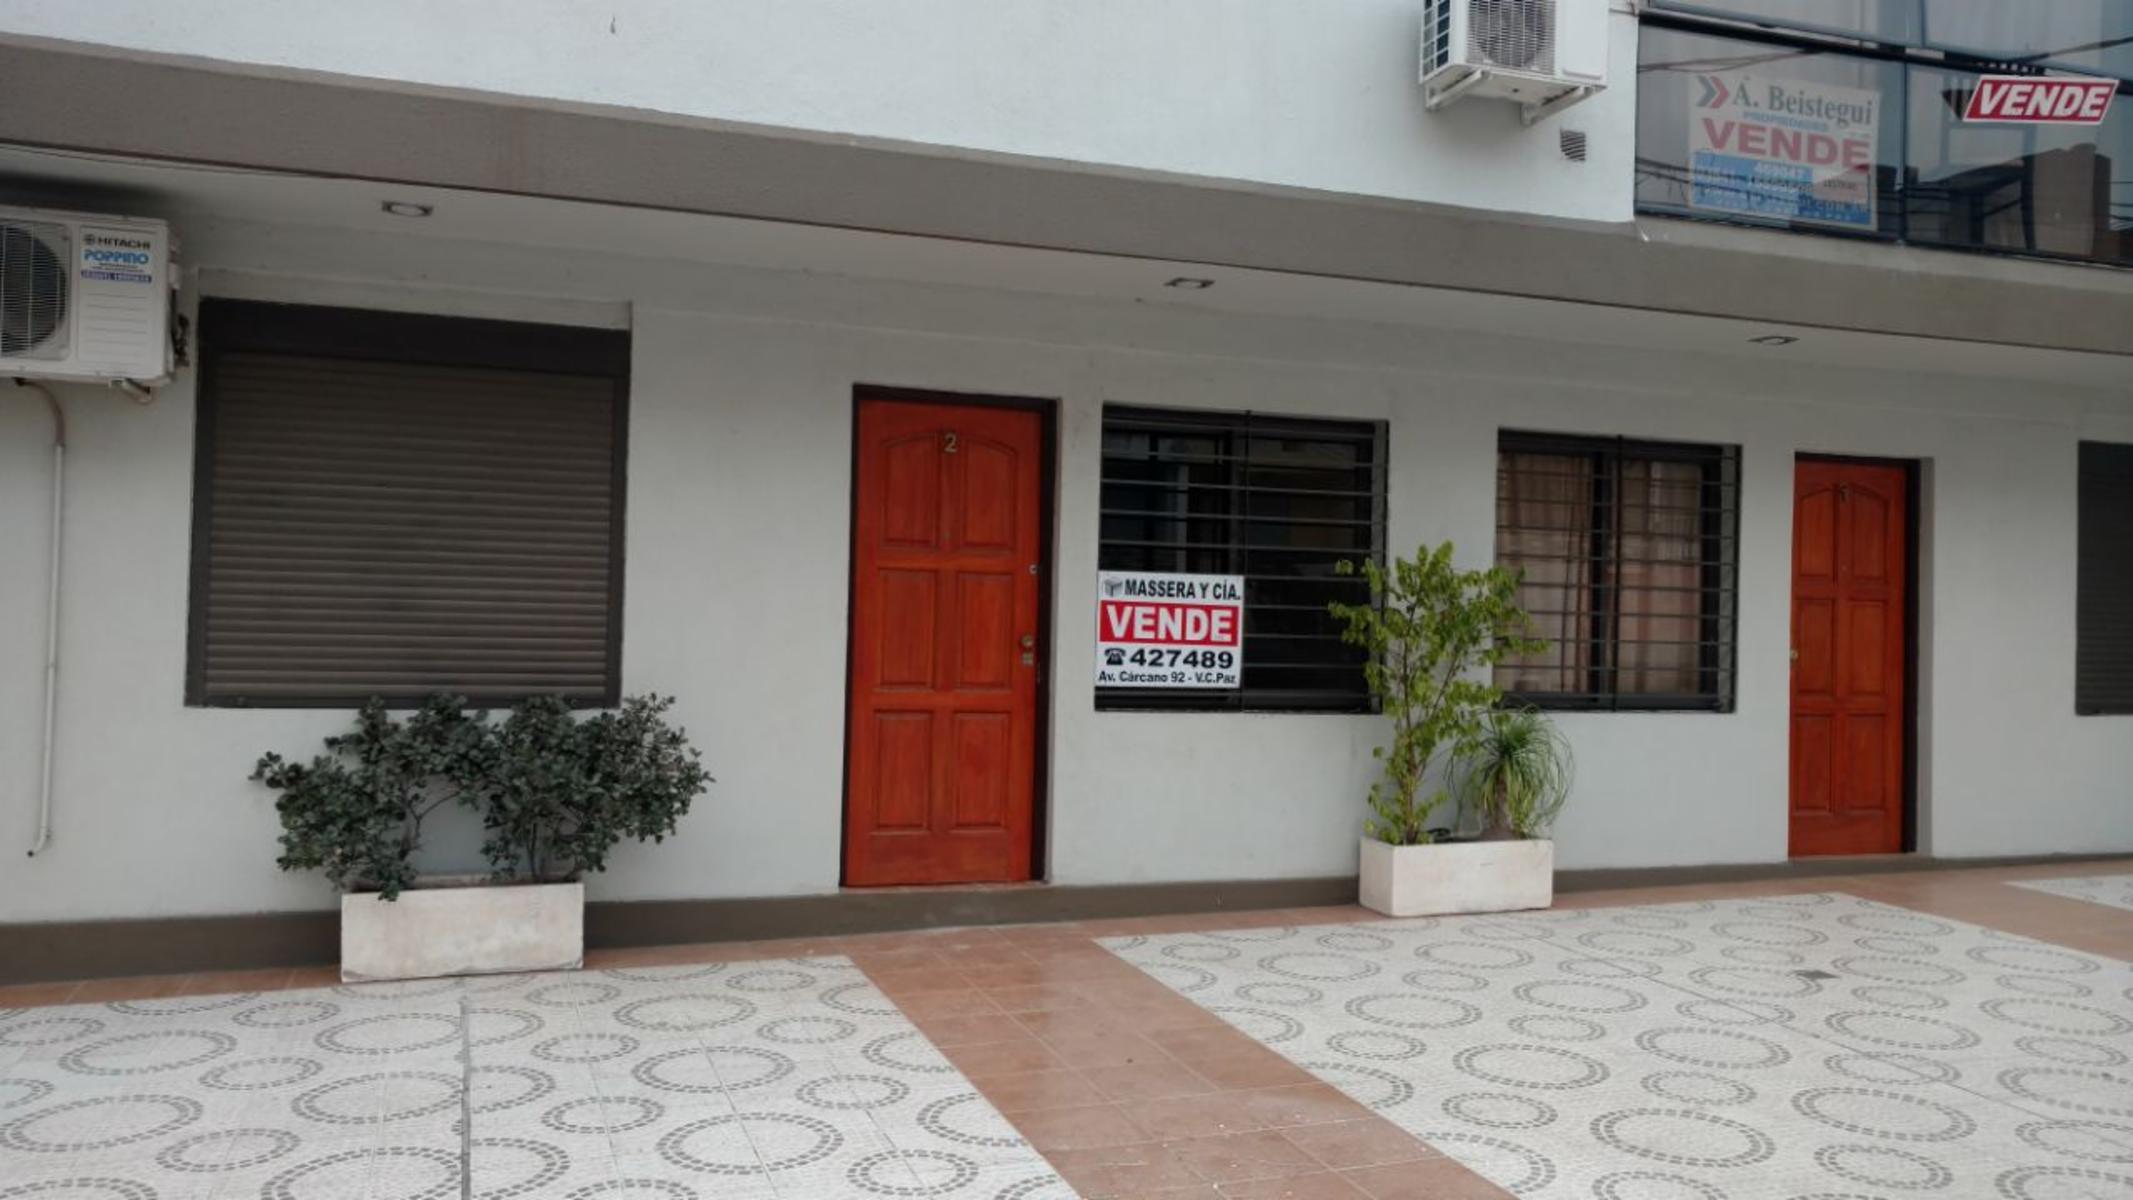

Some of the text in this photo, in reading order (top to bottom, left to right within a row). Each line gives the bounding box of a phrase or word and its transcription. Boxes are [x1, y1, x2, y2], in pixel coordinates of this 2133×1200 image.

[1768, 84, 1872, 129] Beistegui
[1980, 82, 2110, 118] VENDE
[1702, 118, 1870, 171] VENDE
[98, 236, 150, 250] HITACHI
[944, 432, 957, 453] 2
[1125, 579, 1196, 598] MASSERA
[1199, 582, 1210, 599] Y
[1106, 604, 1232, 643] VENDE
[1129, 648, 1233, 669] 427489
[1099, 670, 1116, 682] Av.
[1170, 671, 1185, 683] 92
